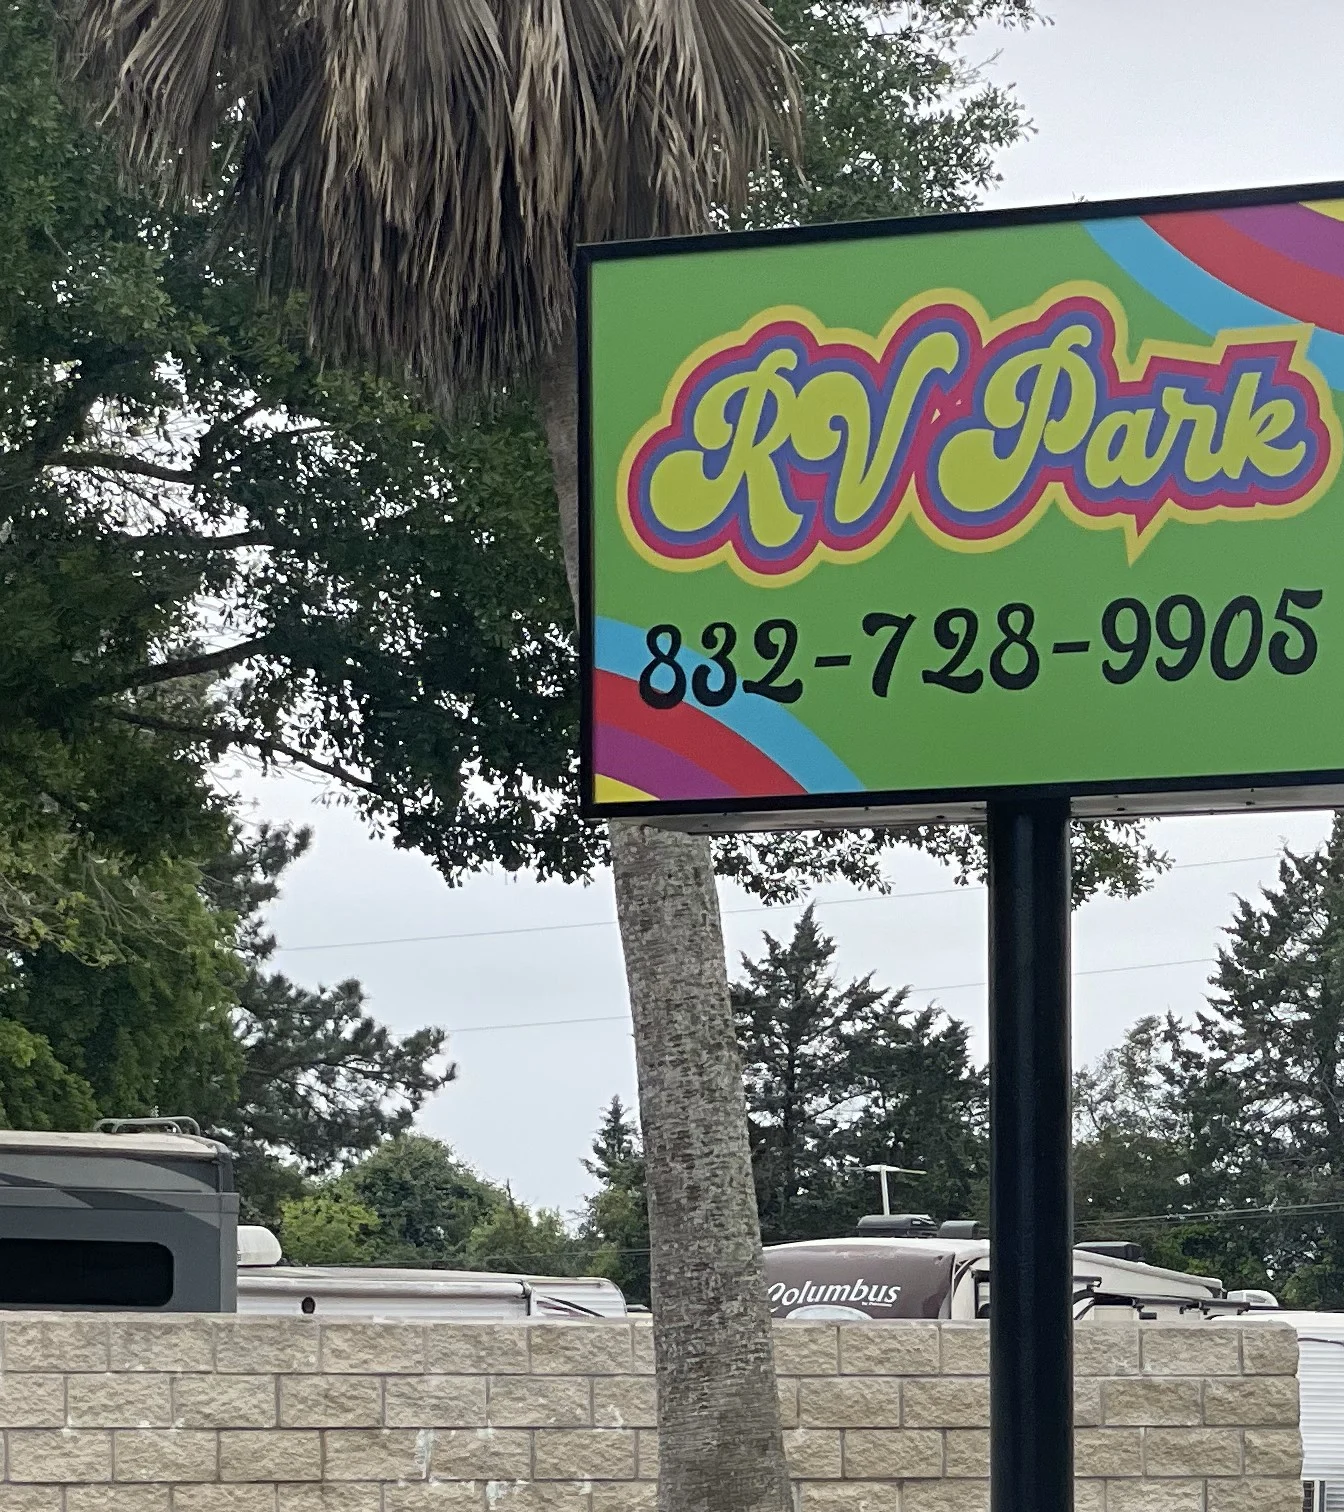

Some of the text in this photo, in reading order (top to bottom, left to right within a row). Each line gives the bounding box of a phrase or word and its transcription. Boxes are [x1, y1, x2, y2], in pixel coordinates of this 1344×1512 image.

[650, 324, 1306, 548] RV Park
[638, 588, 1324, 710] 832-728-9905
